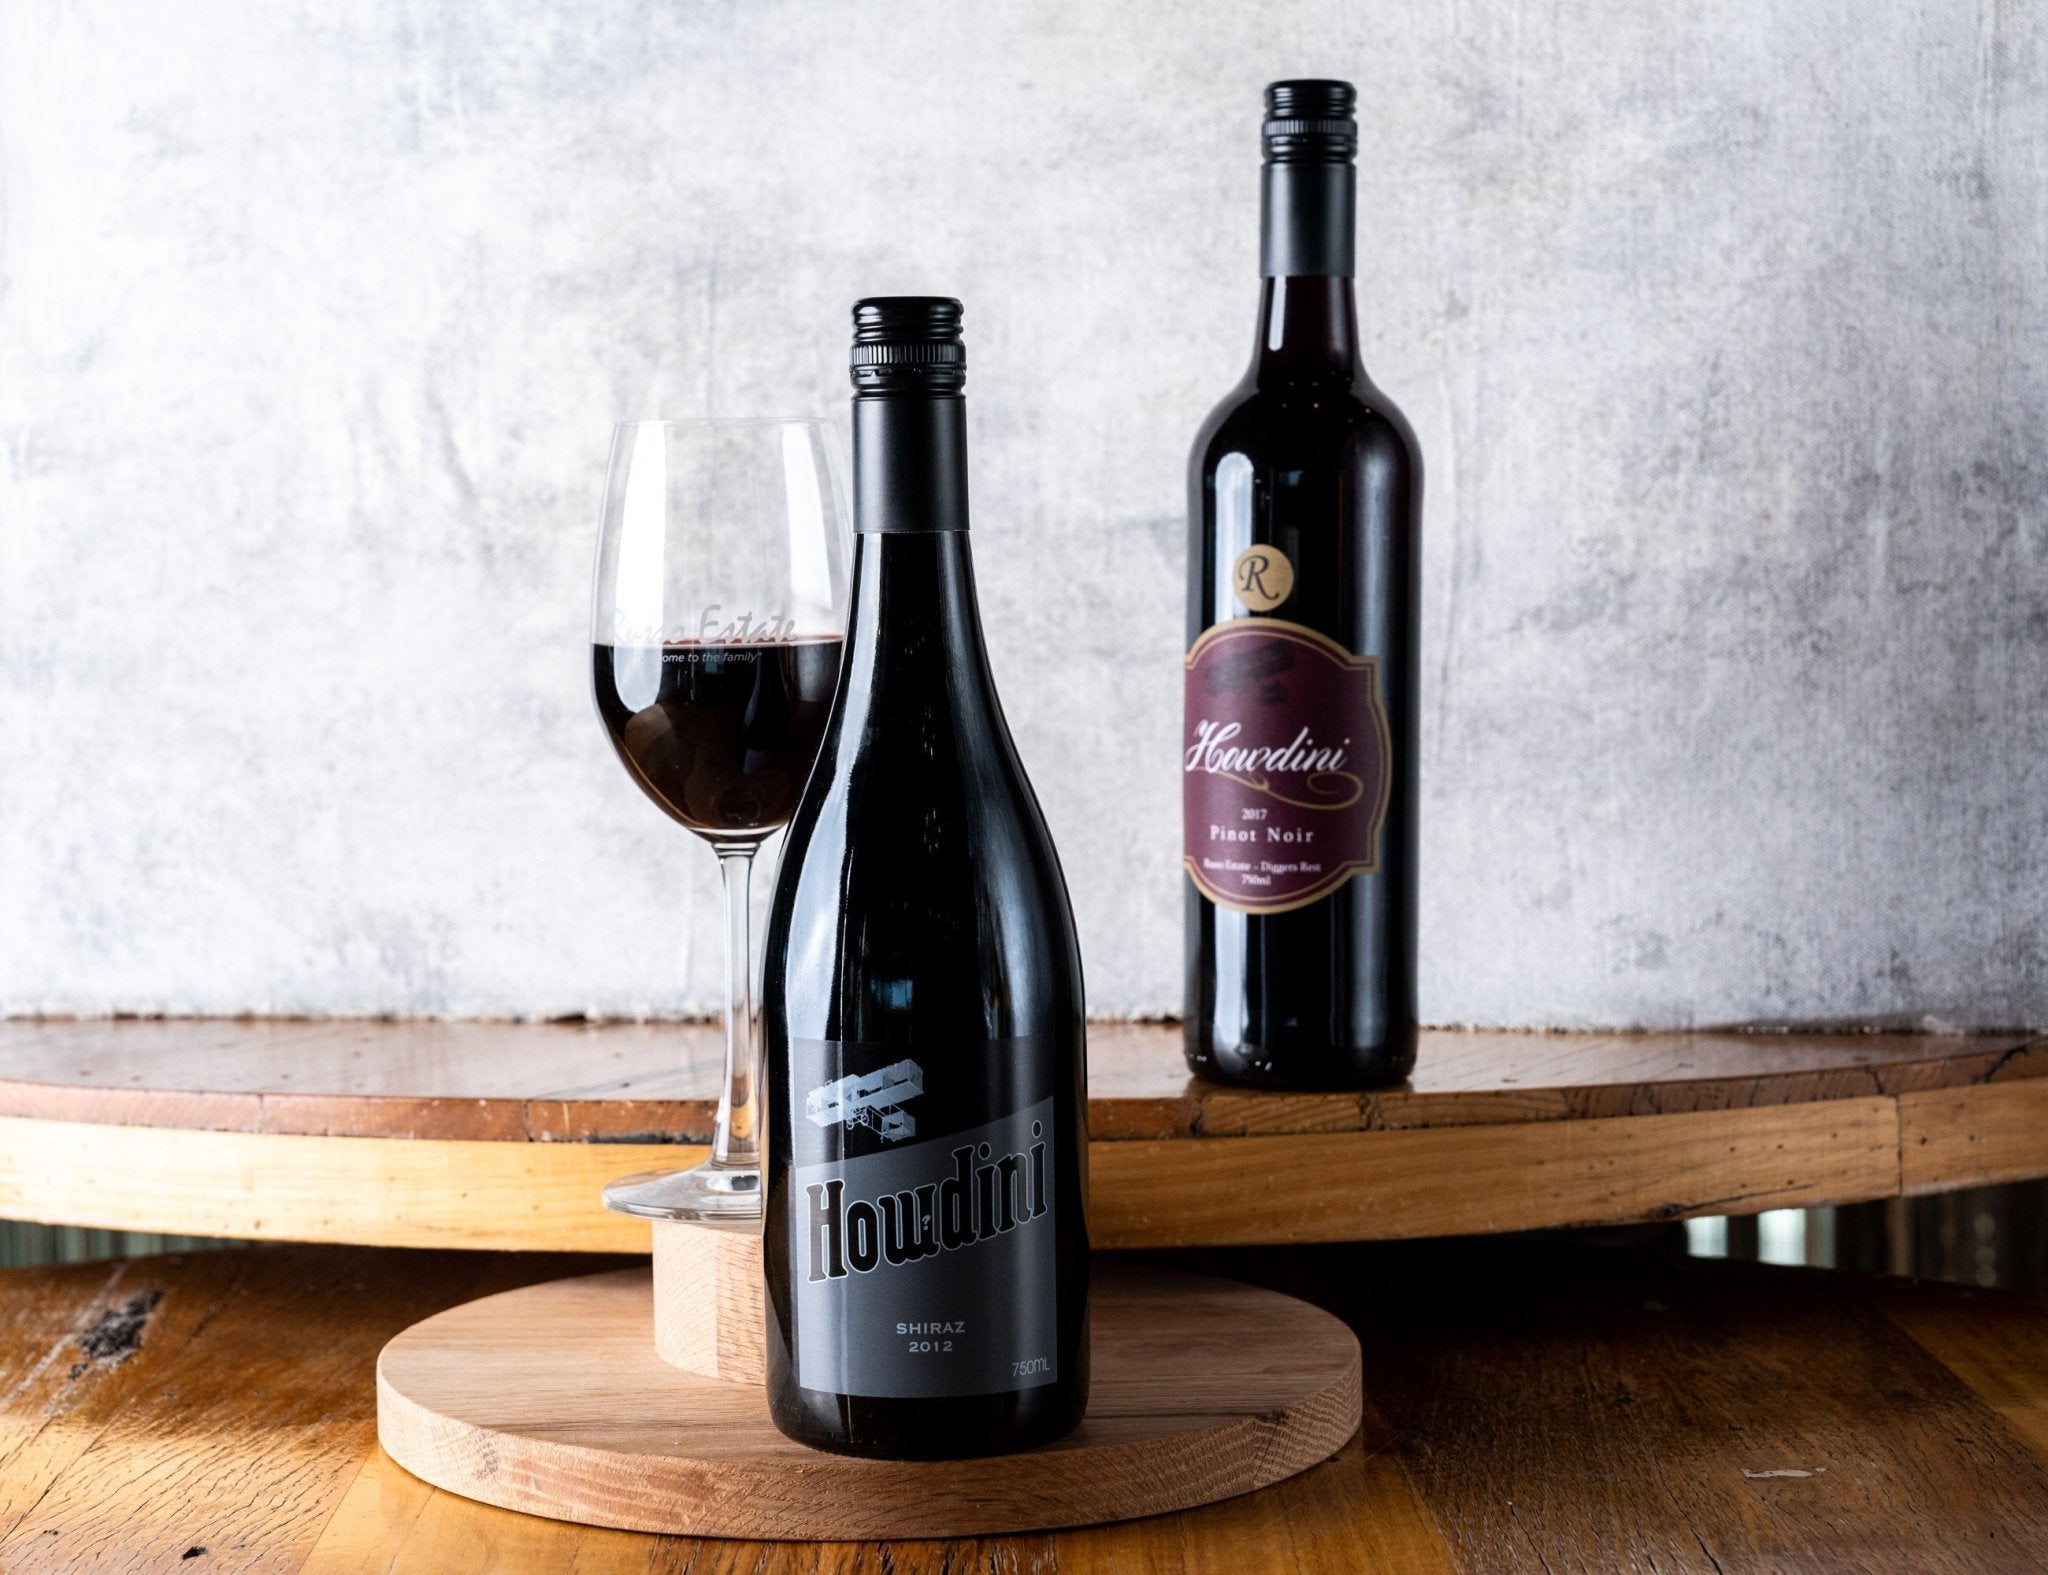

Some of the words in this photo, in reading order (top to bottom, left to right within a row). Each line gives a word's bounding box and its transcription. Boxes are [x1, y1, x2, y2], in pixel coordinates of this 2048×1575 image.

[1238, 554, 1280, 601] R
[699, 604, 799, 644] Estate
[687, 652, 700, 663] to
[702, 651, 721, 663] the
[1184, 719, 1351, 774] Howdini
[1241, 807, 1268, 821] 2017
[1209, 824, 1257, 842] Pinot
[1266, 826, 1314, 843] Noir
[805, 1119, 1048, 1283] Howdini
[896, 1321, 966, 1335] SHIRAZ
[908, 1340, 954, 1353] 2012
